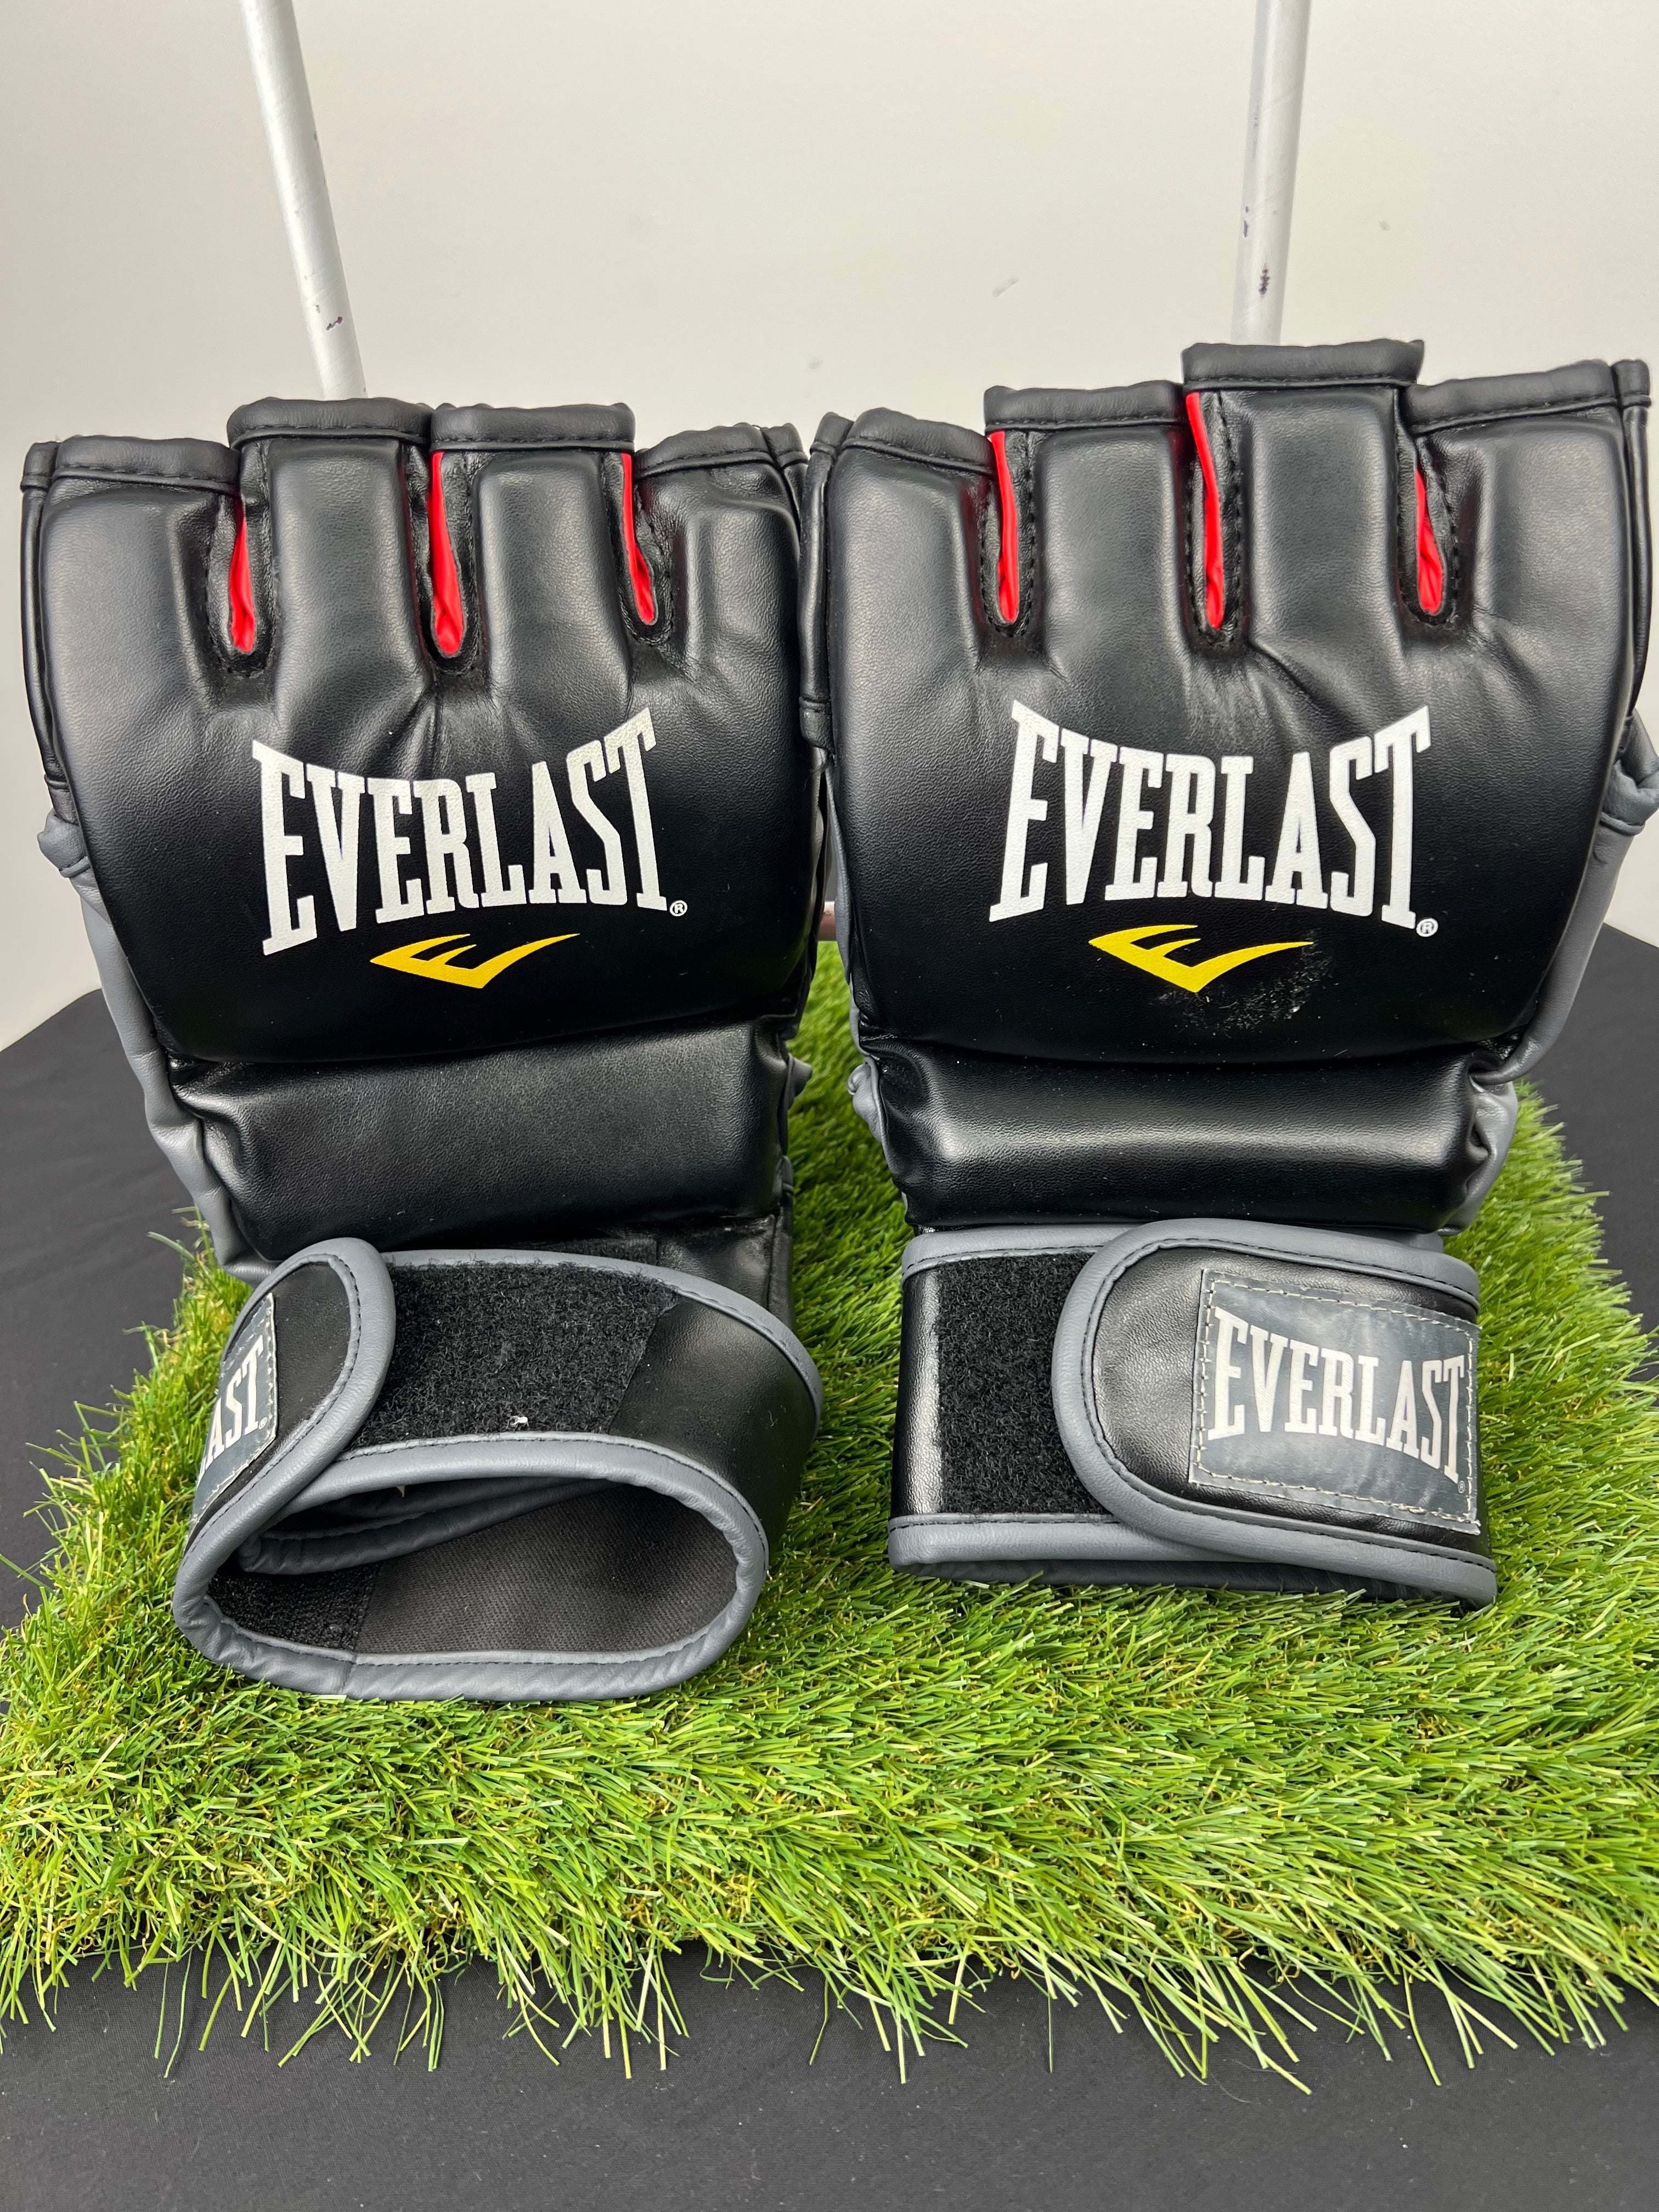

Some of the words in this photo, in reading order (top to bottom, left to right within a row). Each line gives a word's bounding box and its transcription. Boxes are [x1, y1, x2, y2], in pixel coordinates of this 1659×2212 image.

[252, 707, 668, 956] EVERLAST
[989, 700, 1431, 929] EVERLAST
[1208, 1306, 1465, 1484] EVERLAST
